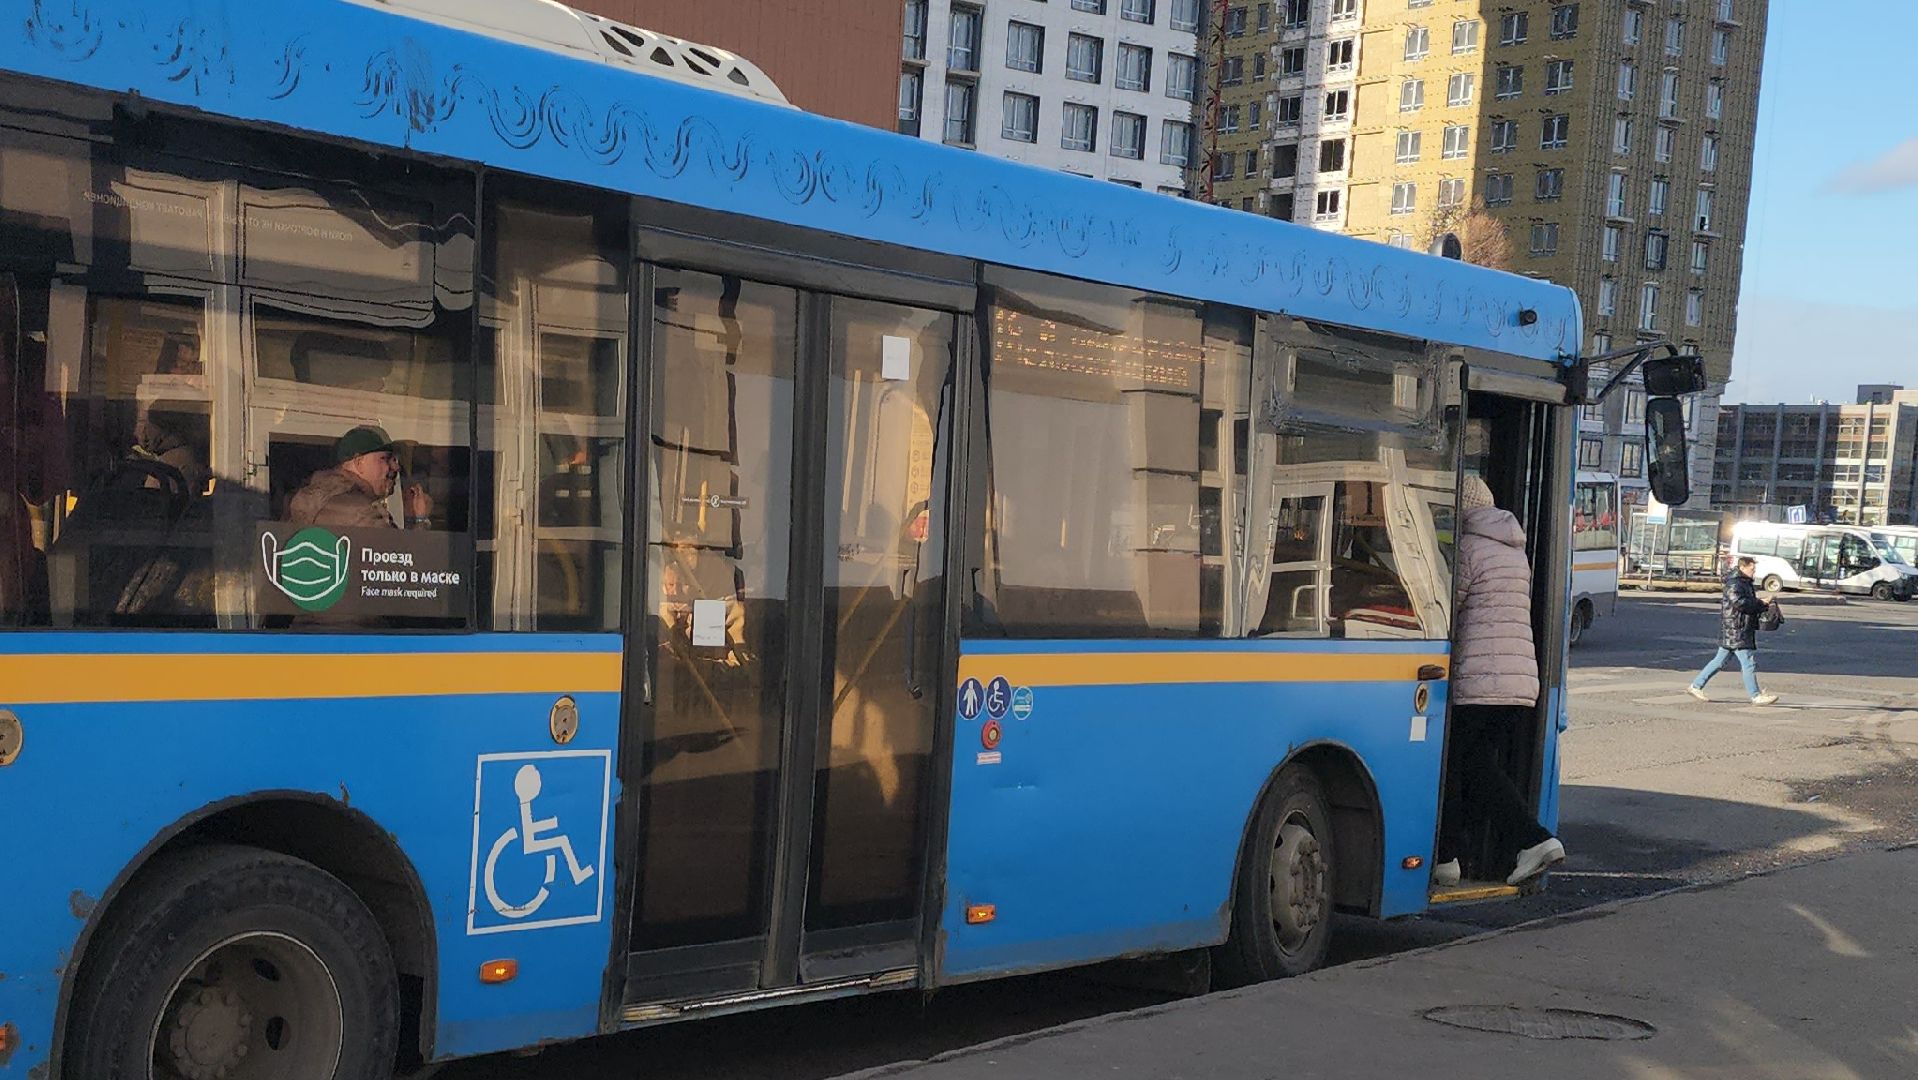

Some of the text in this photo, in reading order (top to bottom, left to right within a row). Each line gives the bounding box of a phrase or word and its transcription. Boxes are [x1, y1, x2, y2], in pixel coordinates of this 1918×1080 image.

[361, 547, 413, 566] Проезд
[360, 569, 460, 584] только в маске
[361, 585, 437, 600] Face mask required
